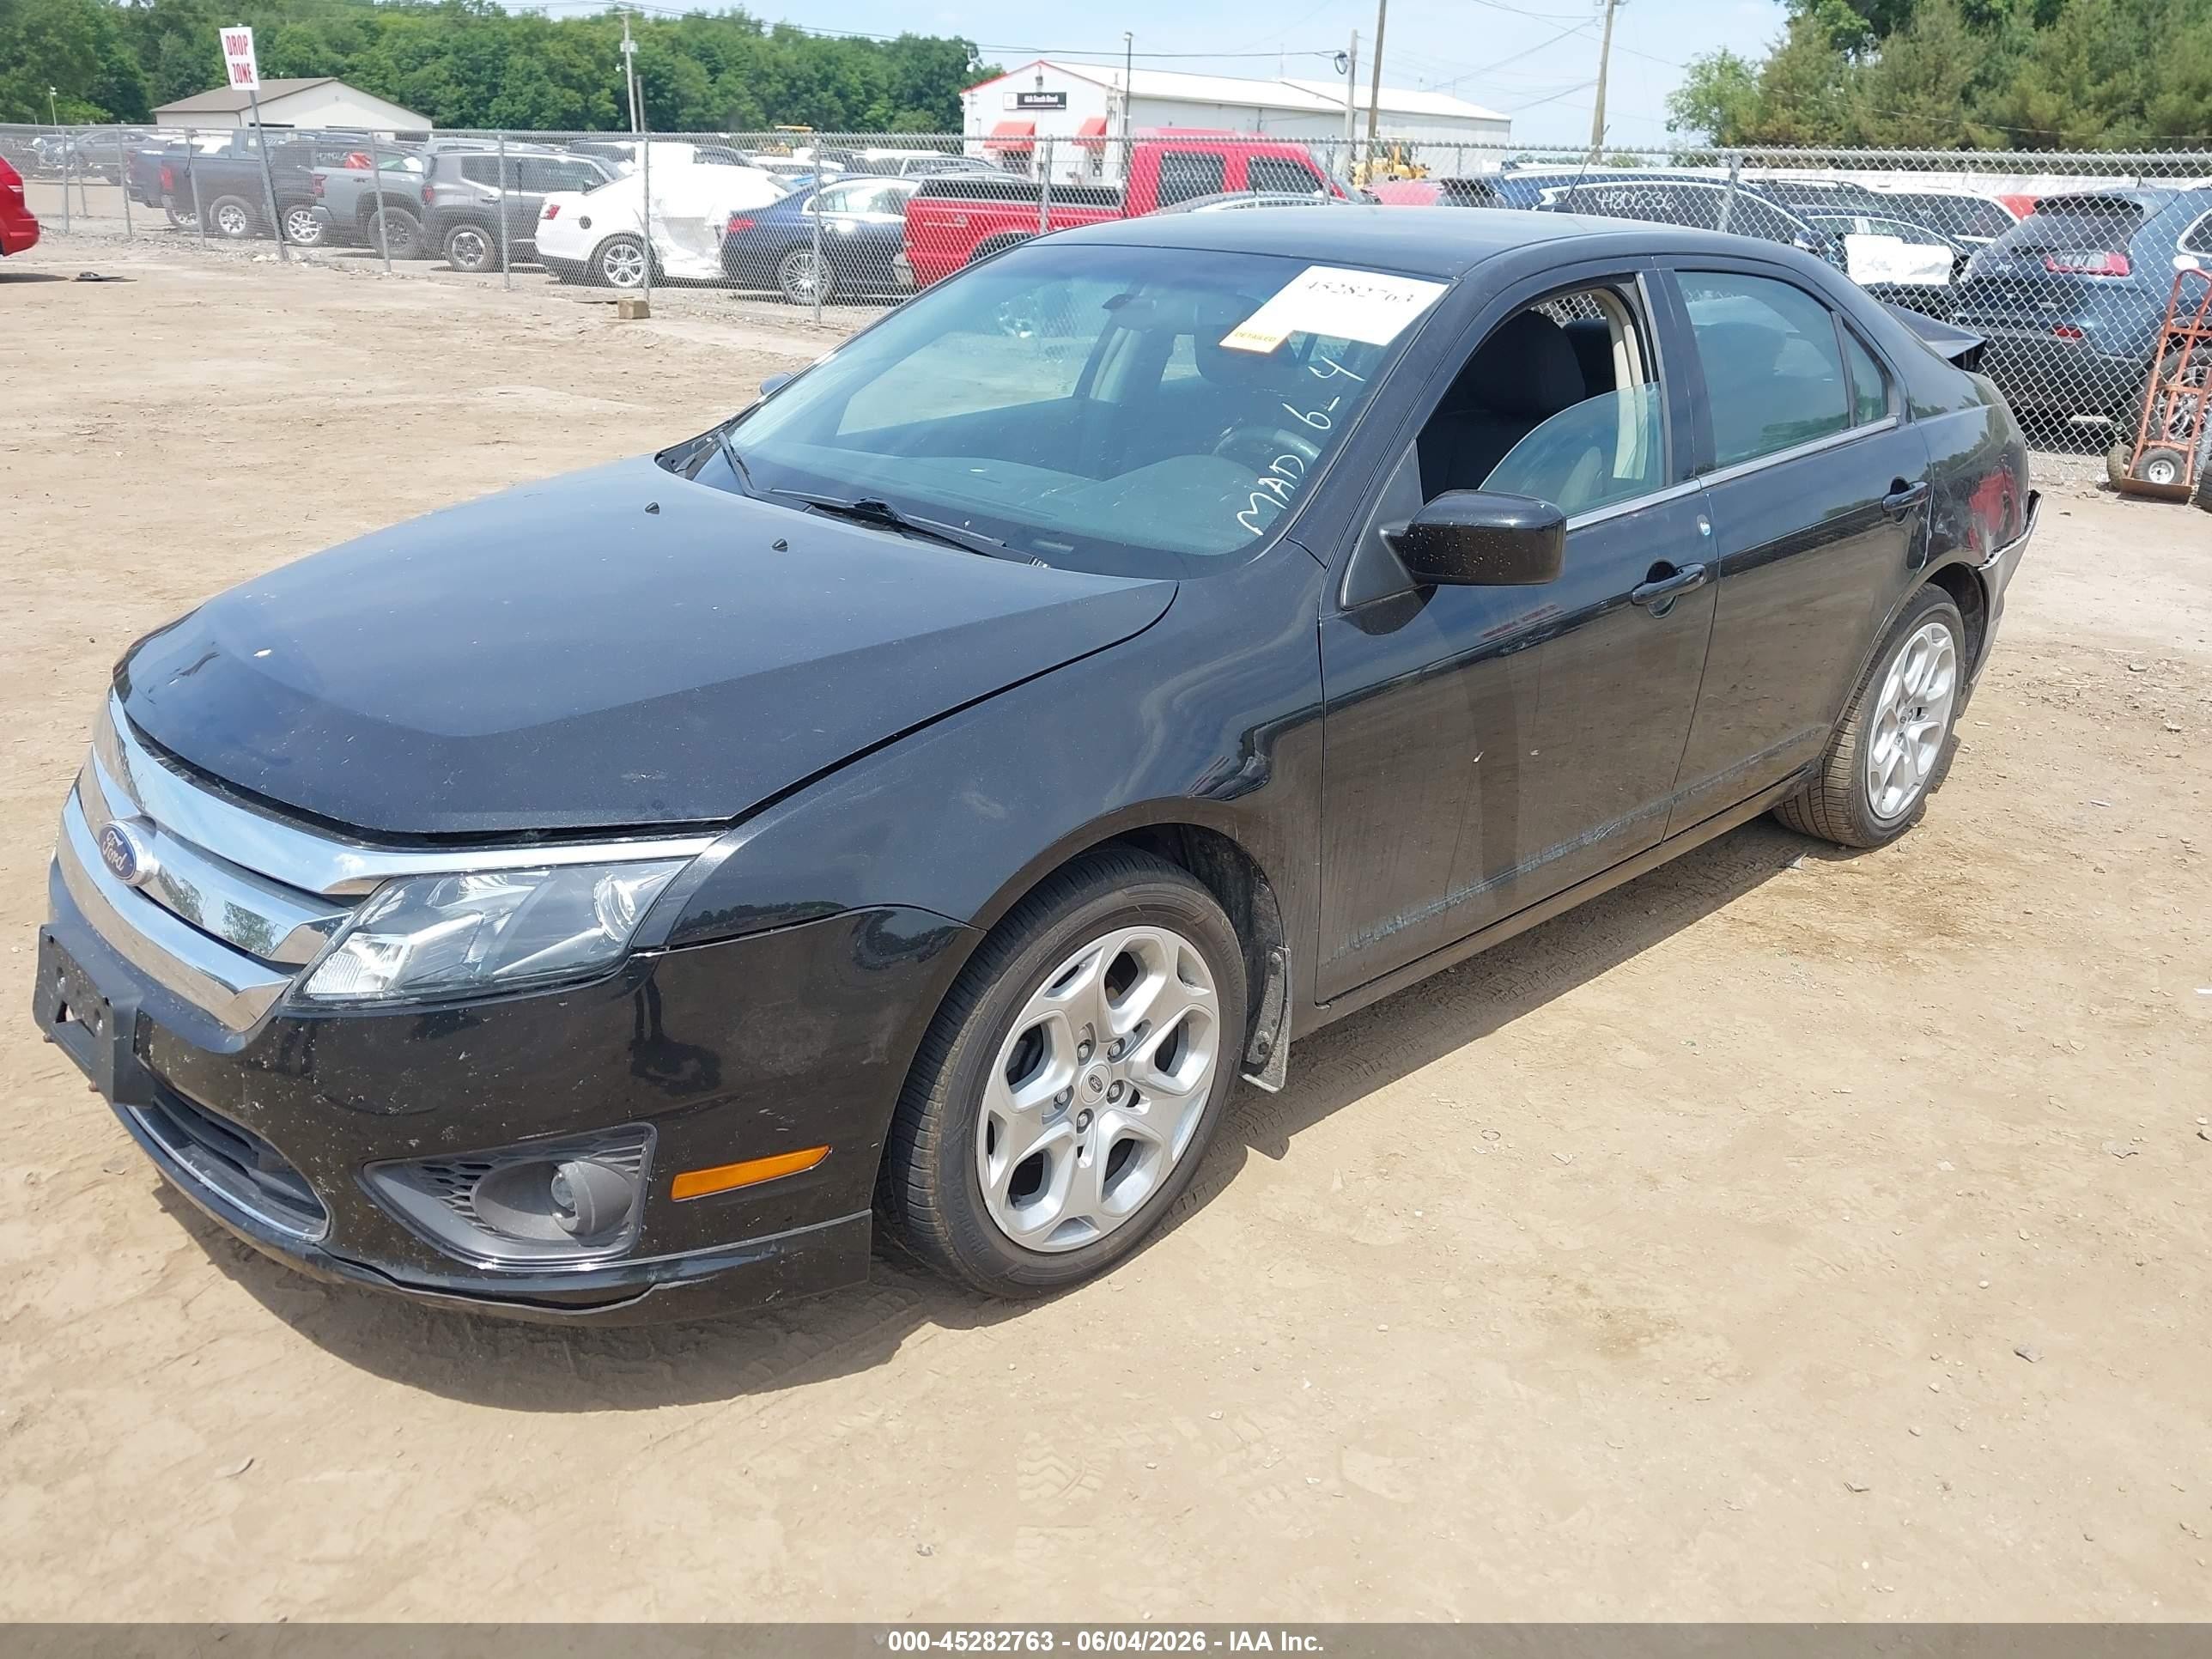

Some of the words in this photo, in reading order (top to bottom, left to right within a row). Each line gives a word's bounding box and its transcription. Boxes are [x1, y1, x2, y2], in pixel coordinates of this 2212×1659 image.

[225, 34, 248, 56] DROP
[232, 63, 253, 83] ZONE
[1237, 454, 1304, 536] MAD
[101, 830, 128, 872] Ford
